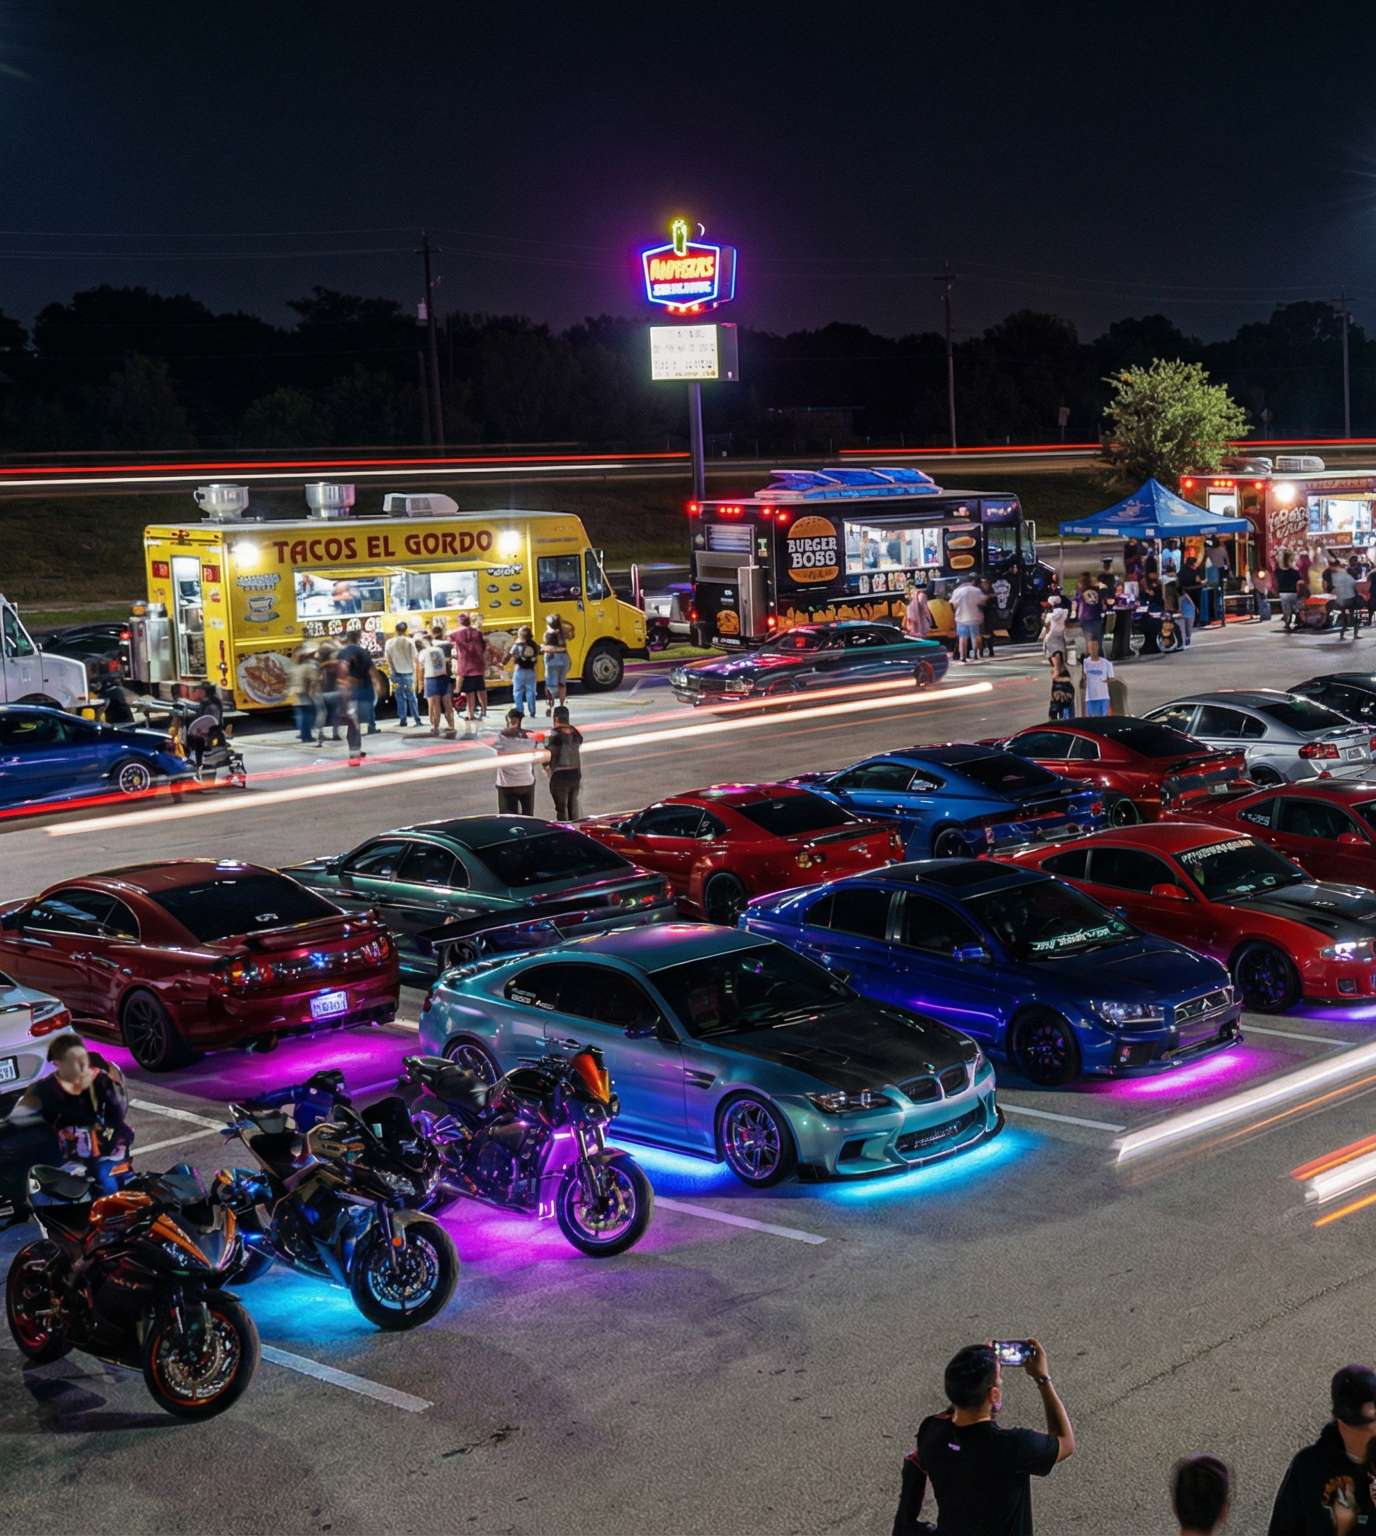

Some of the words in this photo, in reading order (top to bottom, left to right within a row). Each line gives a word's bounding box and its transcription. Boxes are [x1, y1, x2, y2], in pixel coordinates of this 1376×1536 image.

[272, 538, 357, 564] TACOS
[366, 535, 396, 558] EL
[404, 530, 493, 555] GORDO
[786, 537, 838, 553] BURGER
